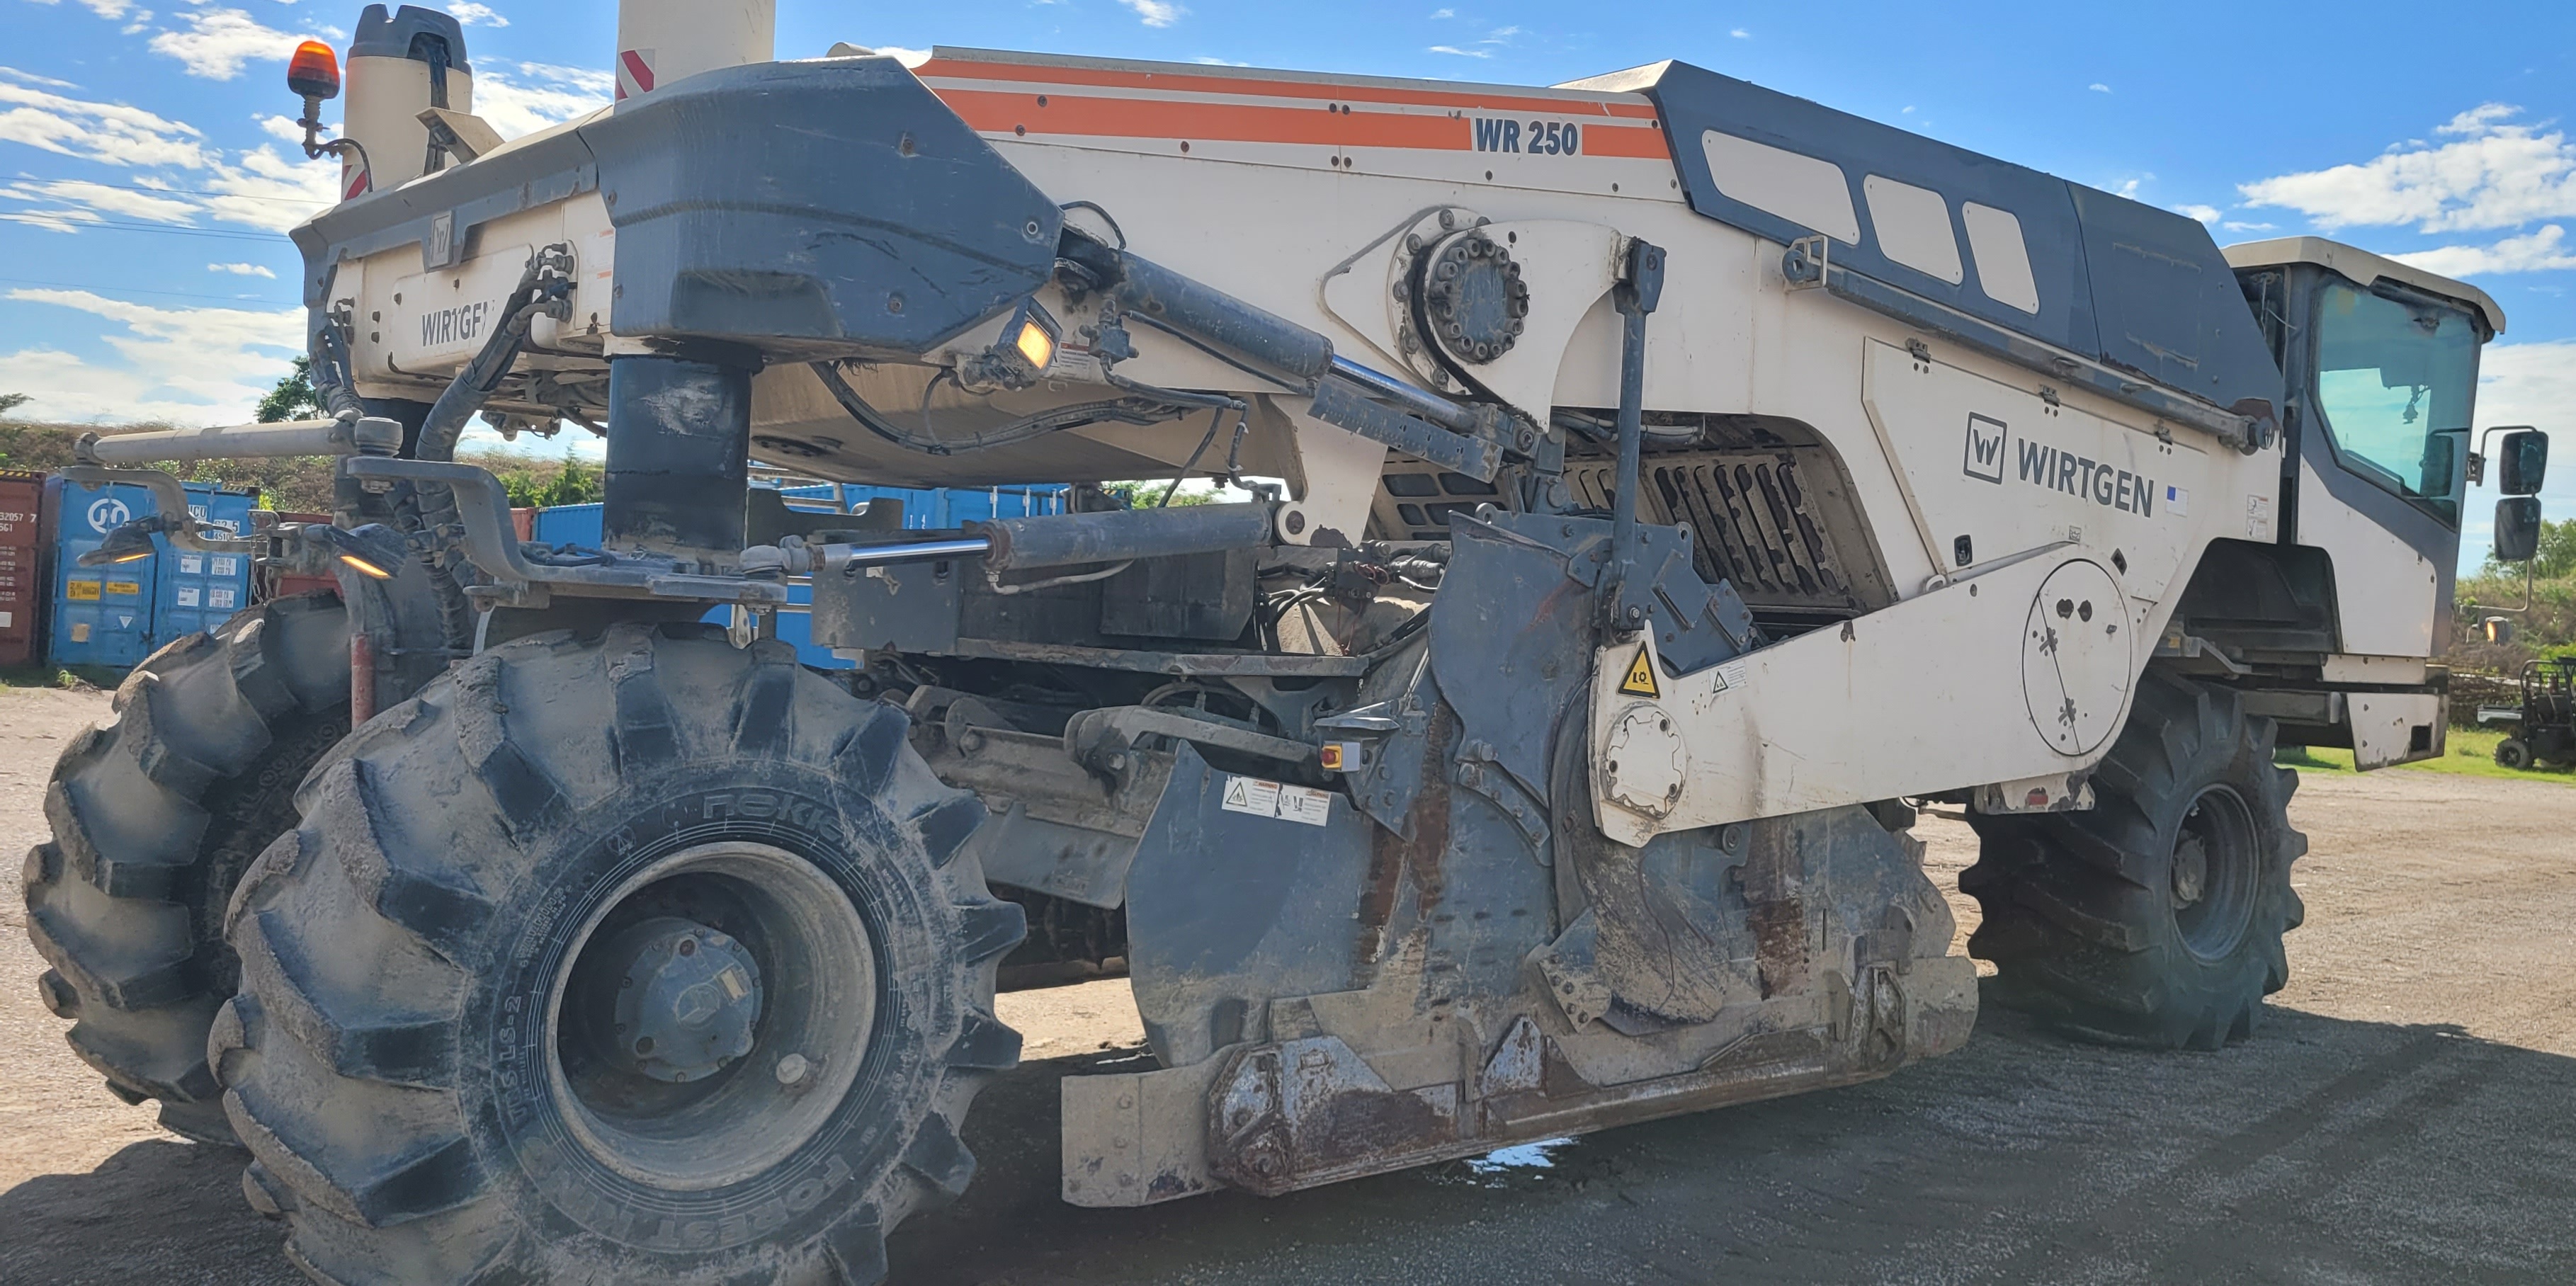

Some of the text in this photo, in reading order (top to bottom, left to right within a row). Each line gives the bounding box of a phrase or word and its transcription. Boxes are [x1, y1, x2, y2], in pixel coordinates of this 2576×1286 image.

[1475, 118, 1578, 156] WR 250
[422, 300, 495, 347] WIRTGE
[2018, 437, 2155, 518] WIRTGEN
[30, 513, 37, 523] 7
